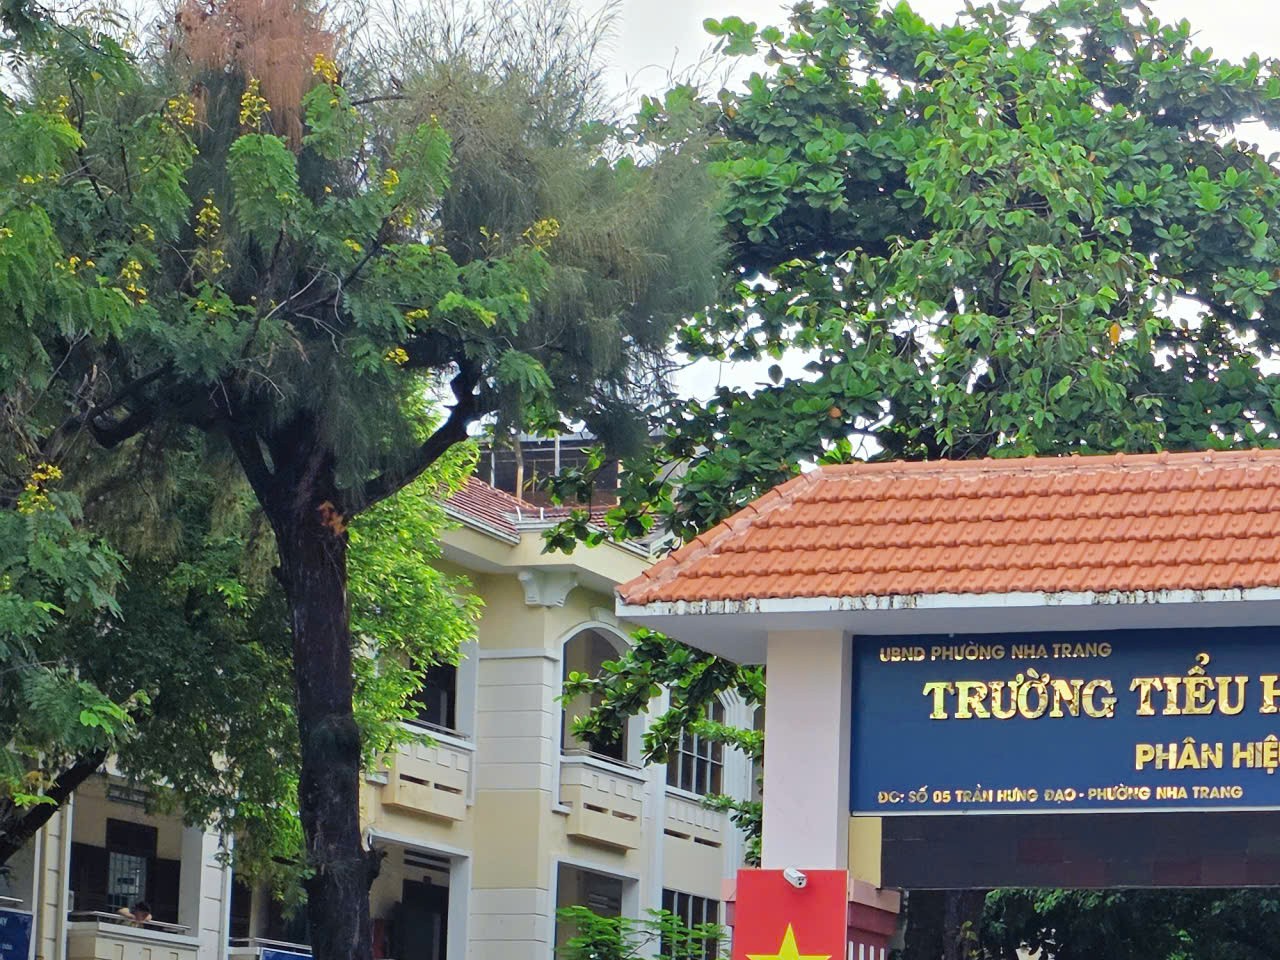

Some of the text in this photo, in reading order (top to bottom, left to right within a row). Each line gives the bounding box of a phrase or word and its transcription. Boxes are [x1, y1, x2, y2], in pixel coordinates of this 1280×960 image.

[879, 640, 1113, 662] UBND PHƯỜNG NHA TRANG
[922, 667, 1118, 720] TRƯỜNG
[1129, 652, 1251, 717] TIỂU
[1135, 736, 1223, 771] PHÂN
[877, 791, 905, 804] ĐC:
[908, 785, 929, 803] SỐ
[932, 790, 951, 803] 05
[997, 787, 1039, 803] HƯNG
[1044, 788, 1077, 804] ĐẠO
[1088, 783, 1151, 801] PHƯỜNG
[1156, 786, 1188, 800] NHA
[1192, 785, 1244, 799] TRANG
